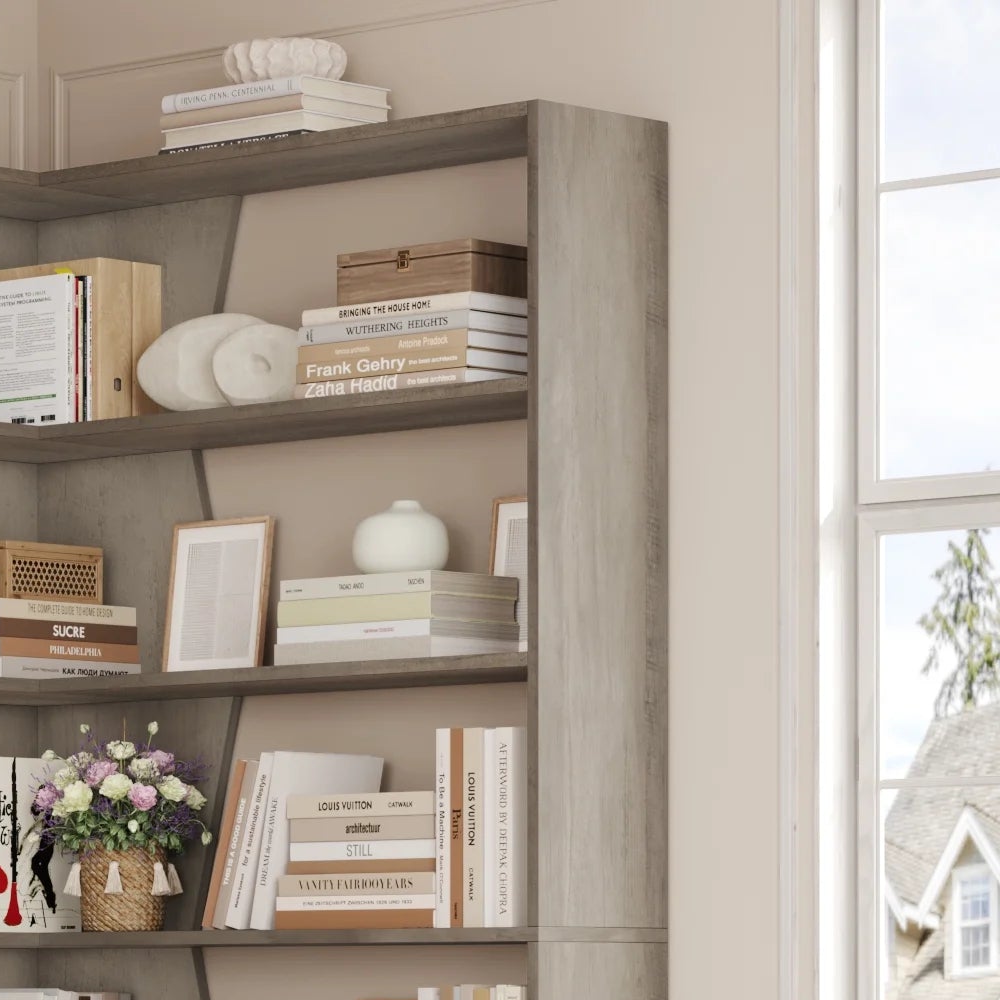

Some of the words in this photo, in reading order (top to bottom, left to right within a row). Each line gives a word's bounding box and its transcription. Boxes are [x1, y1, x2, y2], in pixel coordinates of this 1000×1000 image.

[181, 94, 207, 105] IRVING
[338, 309, 371, 319] BRINGING
[373, 306, 386, 315] THE
[387, 302, 410, 313] HOUSE
[412, 299, 431, 310] HOME
[346, 321, 403, 336] WUTHERING
[408, 316, 449, 330] HEIGHTS
[306, 363, 352, 378] Frank
[356, 357, 406, 373] Gehry
[431, 354, 458, 363] architects
[305, 380, 346, 399] Zaha
[351, 374, 398, 394] Hadid
[407, 378, 416, 386] the
[52, 624, 86, 639] SUCRE
[49, 644, 102, 657] PHILADELPHIA
[62, 667, 76, 676] КАК
[77, 668, 98, 677] ЛЮДИ
[439, 774, 445, 784] To
[499, 742, 508, 809] AFTERWORD
[467, 772, 475, 801] LOUIS
[318, 801, 340, 812] LOUIS
[341, 800, 373, 811] VUITTON
[241, 855, 249, 867] for
[248, 804, 260, 848] sustainable
[255, 774, 267, 803] lifestyle
[345, 822, 381, 834] architectuur
[452, 808, 461, 840] Paris
[467, 804, 475, 846] VUITTON
[499, 811, 508, 826] BY
[223, 870, 232, 886] THIS
[231, 824, 241, 850] GOOD
[236, 797, 247, 823] GUIDE
[346, 843, 373, 857] STILL
[499, 828, 508, 869] DEEPAK
[298, 879, 334, 890] VANITY
[337, 879, 360, 890] FAIR
[378, 878, 414, 889] YEARS
[499, 872, 508, 915] CHOPRA
